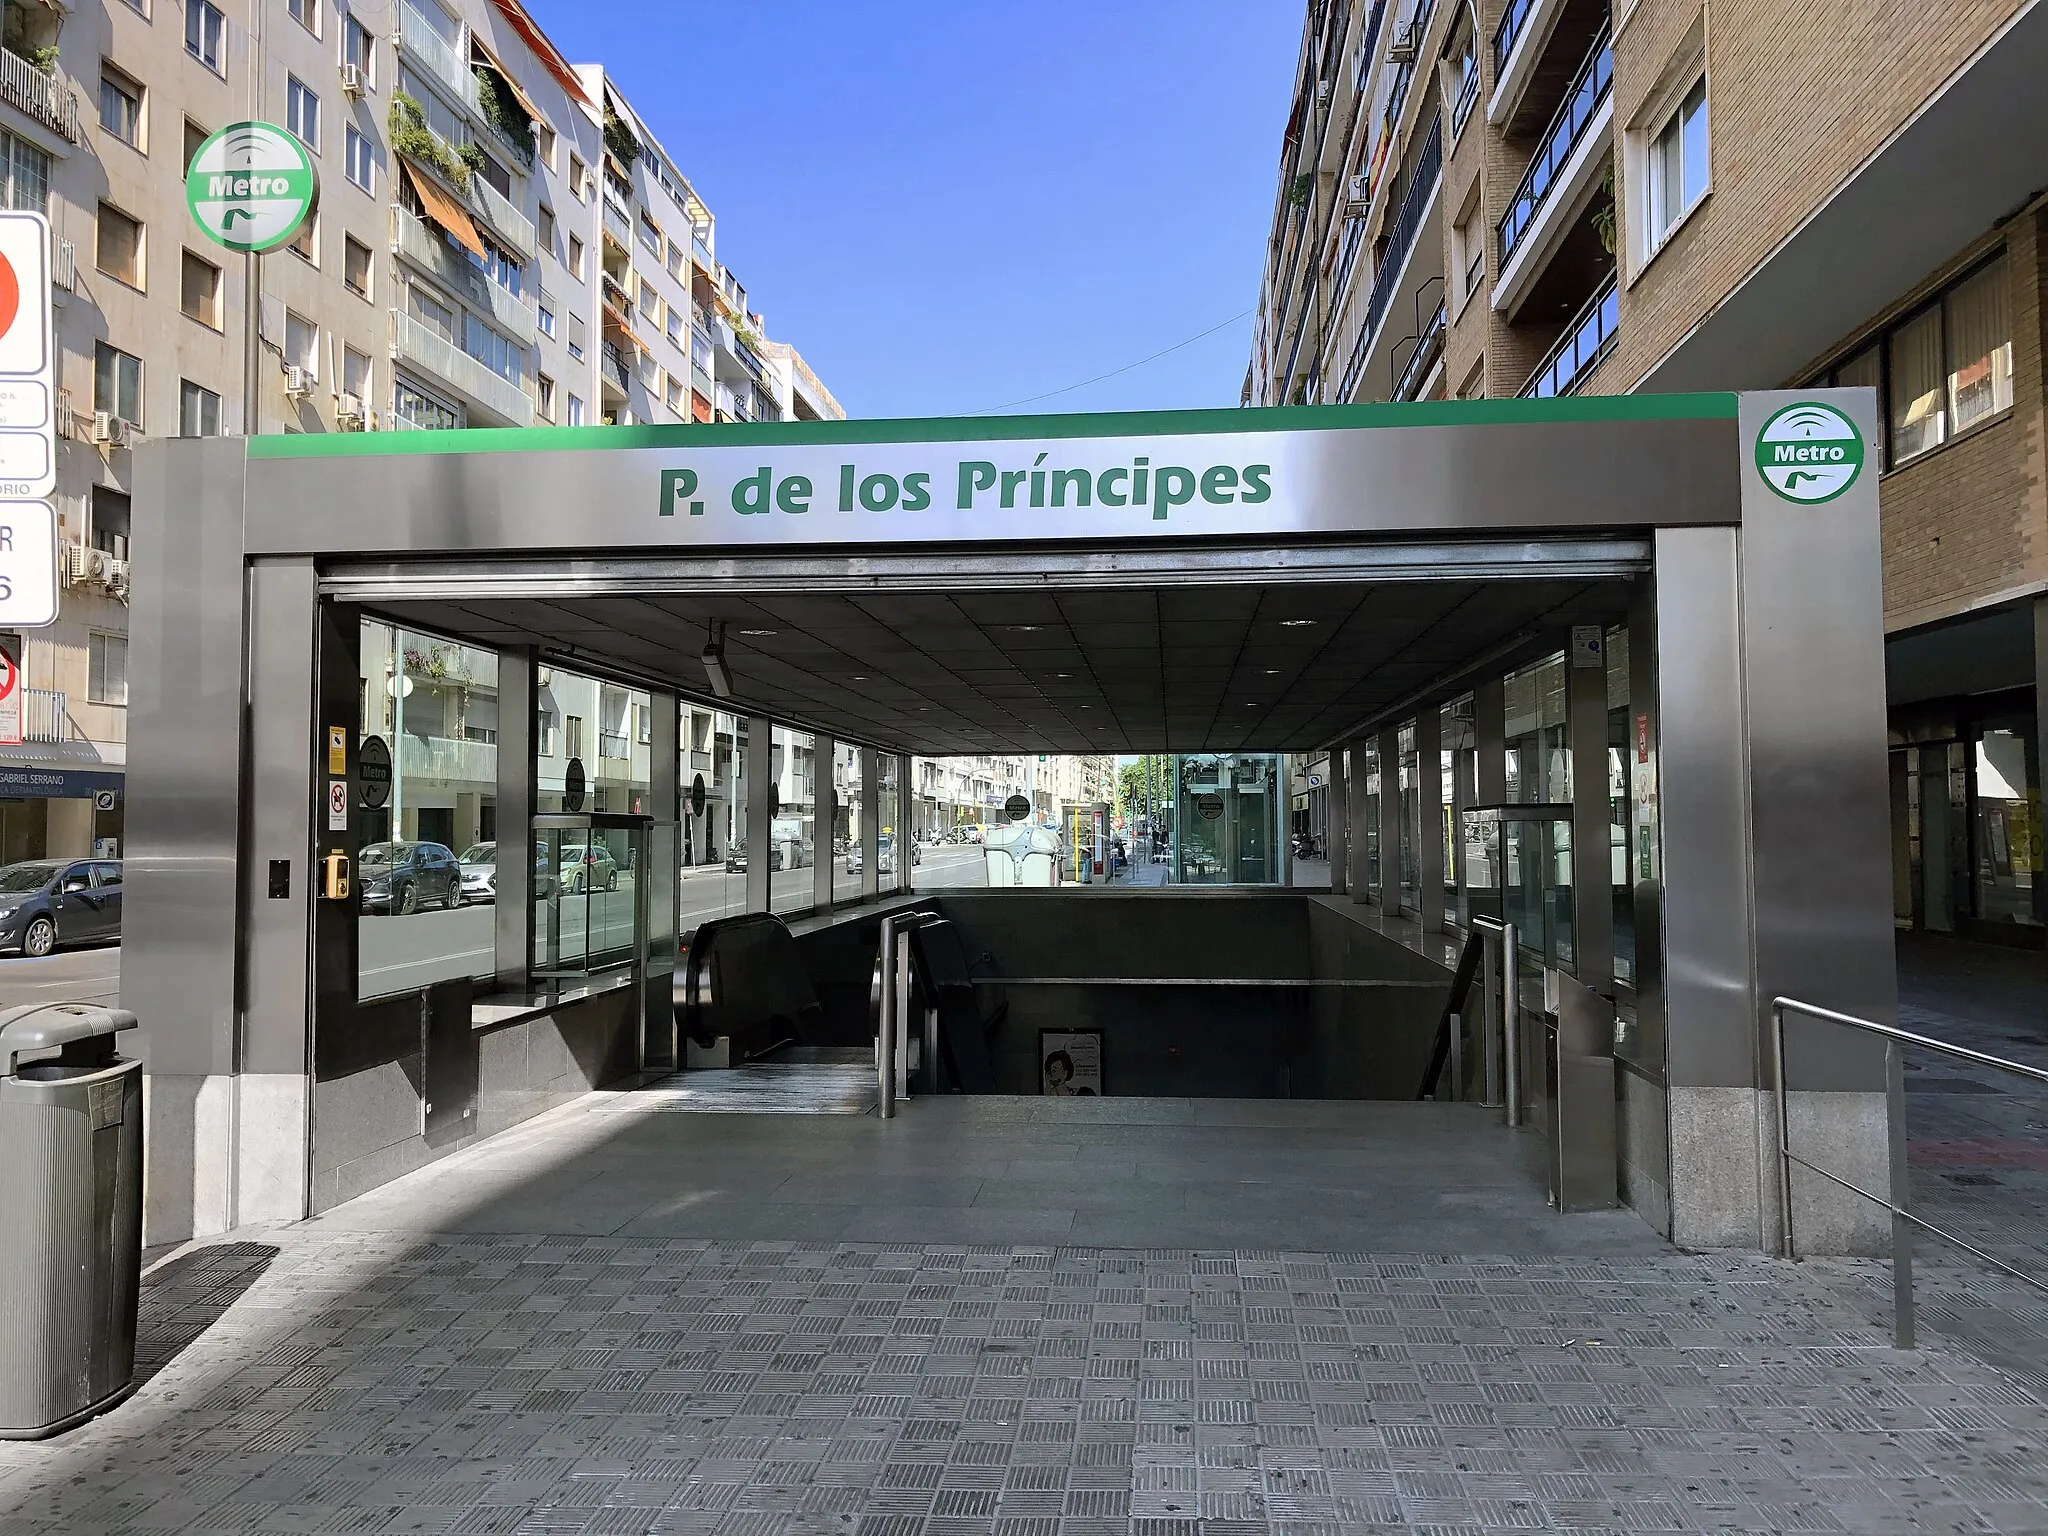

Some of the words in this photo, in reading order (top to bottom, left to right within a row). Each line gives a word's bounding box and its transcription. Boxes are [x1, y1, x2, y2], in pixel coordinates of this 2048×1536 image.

[208, 173, 289, 197] Metro
[1774, 445, 1845, 462] Metro
[0, 484, 30, 495] RIO
[659, 468, 704, 516] P.
[731, 466, 812, 515] de
[838, 464, 931, 512] los
[957, 452, 1271, 520] Príncipes
[30, 774, 64, 785] SERRANO
[362, 765, 386, 779] Metro
